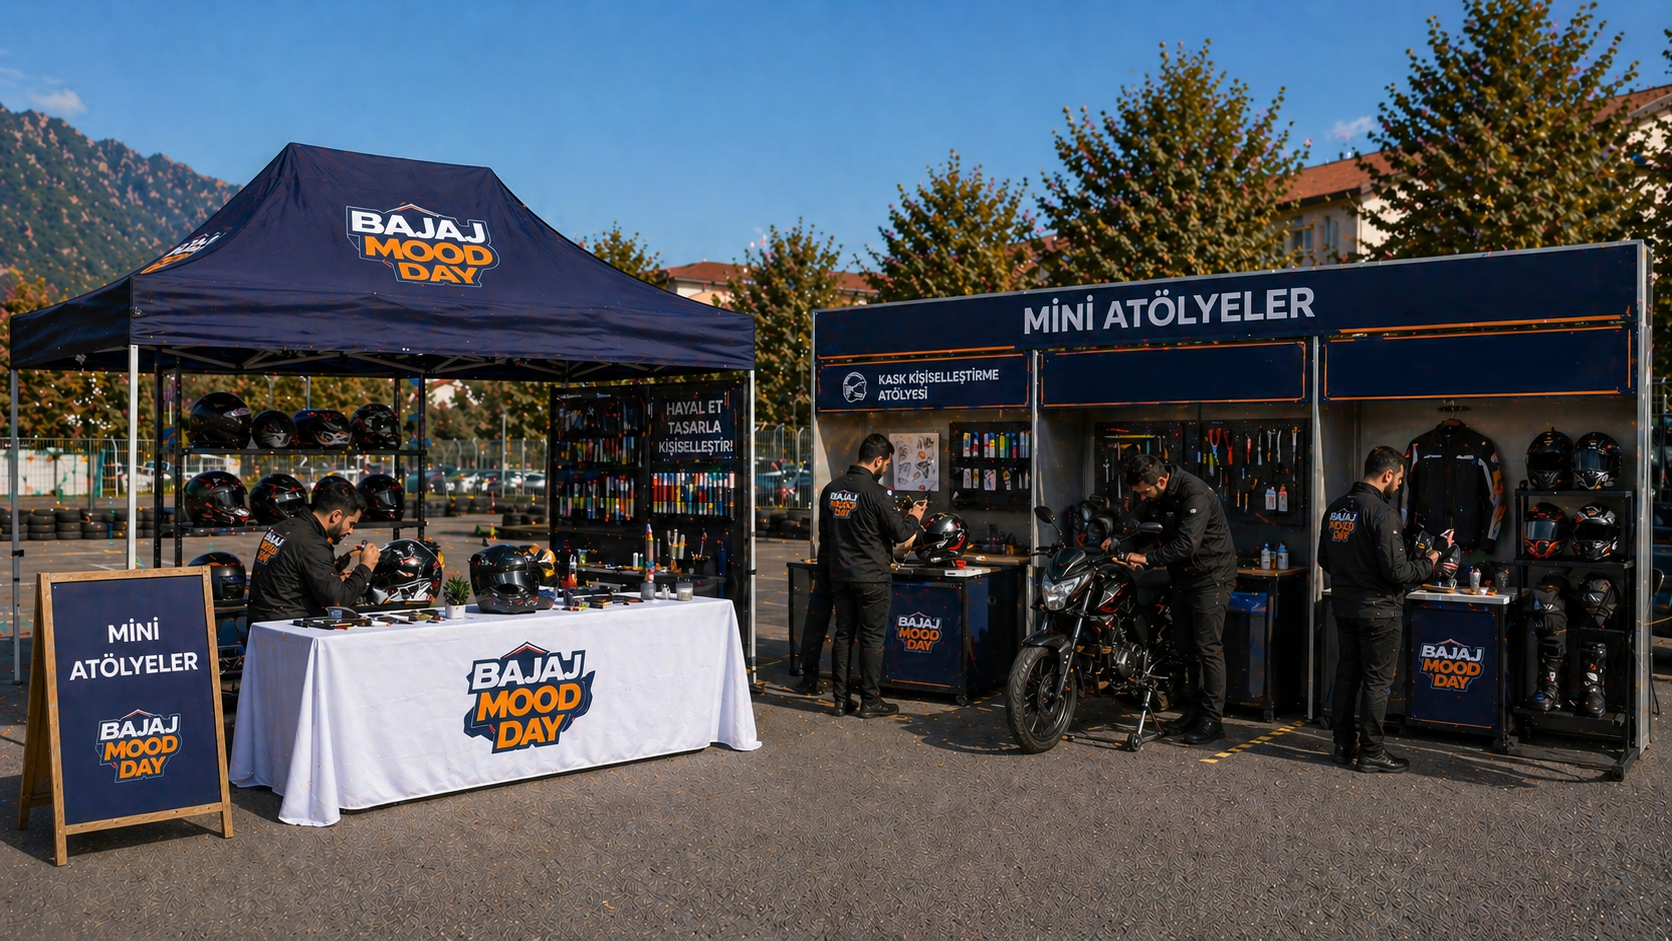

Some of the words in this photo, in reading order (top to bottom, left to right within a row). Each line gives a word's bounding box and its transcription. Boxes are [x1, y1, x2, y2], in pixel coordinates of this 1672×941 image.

[351, 210, 486, 244] BAJAJ
[364, 235, 493, 266] MOOD
[397, 261, 478, 284] DAY
[1023, 294, 1093, 335] MİNİ
[1103, 287, 1316, 330] ATÖLYELER
[878, 373, 907, 385] KASK
[908, 367, 1000, 386] KİŞİSELLEŞTİRME
[877, 386, 928, 401] ATÖLYESİ
[666, 400, 706, 416] HAYAL
[708, 399, 724, 414] ET
[667, 420, 722, 435] TASARLA
[658, 436, 733, 456] KİŞİSELLEŞTİR!
[108, 616, 160, 644] MİNİ
[898, 616, 941, 629] BAJAJ
[898, 627, 940, 641] MOOD
[906, 639, 934, 651] DAY
[1421, 645, 1483, 662] BAJAJ
[69, 651, 199, 681] ATÖLYELER
[472, 653, 583, 690] BAJAJ
[1422, 658, 1481, 676] MOOD
[1433, 673, 1470, 689] DAY
[476, 682, 582, 722] MOOD
[100, 715, 179, 741] BAJAJ
[496, 714, 566, 750] DAY
[103, 735, 178, 761] MOOD
[119, 755, 167, 779] DAY
